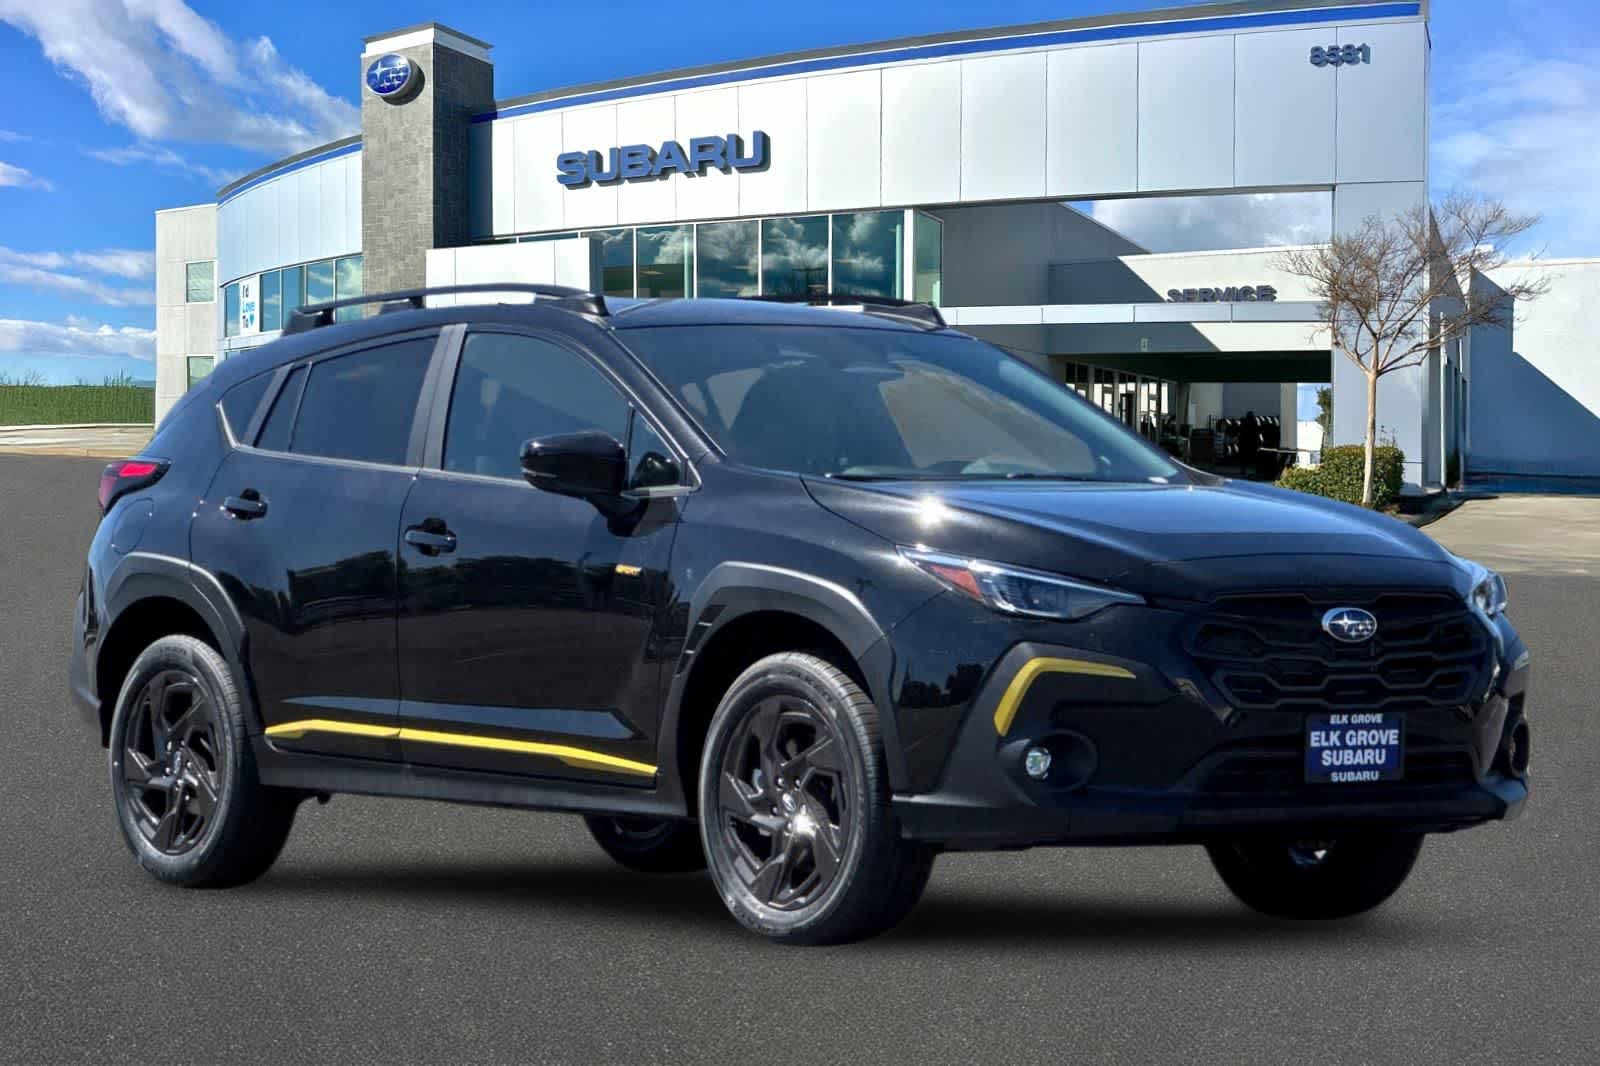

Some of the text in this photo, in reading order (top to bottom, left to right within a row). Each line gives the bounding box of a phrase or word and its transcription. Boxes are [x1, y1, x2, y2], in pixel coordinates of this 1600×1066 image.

[556, 130, 771, 190] SUBARU
[1166, 285, 1278, 303] SERVICE
[1329, 713, 1384, 725] ELK GROVE
[1310, 729, 1399, 747] ELK GROVE
[1321, 748, 1387, 766] SUBARU
[1330, 771, 1380, 782] SUBARU
